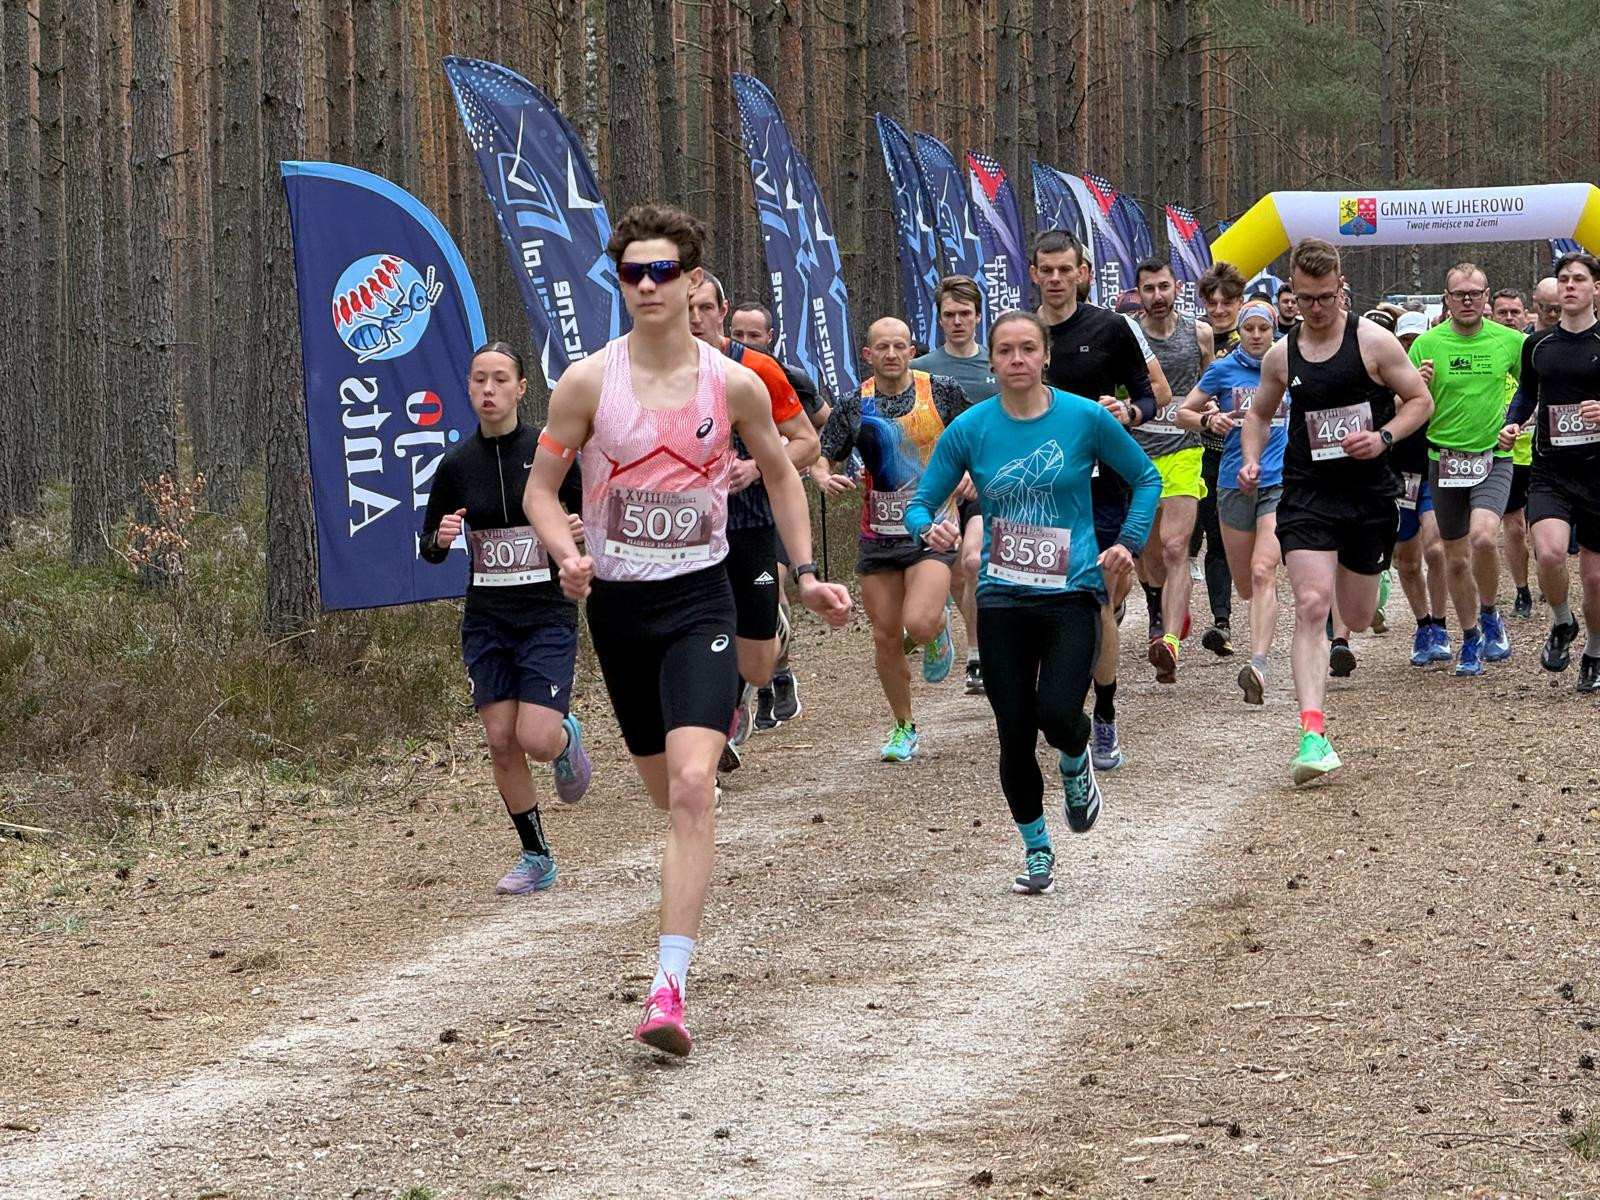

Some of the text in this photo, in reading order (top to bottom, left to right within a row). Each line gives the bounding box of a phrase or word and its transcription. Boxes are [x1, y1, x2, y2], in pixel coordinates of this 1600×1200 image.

[1381, 197, 1524, 217] GMINA WEJHEROWO
[1406, 217, 1498, 231] Twoje miejsce na Ziemi
[1317, 414, 1361, 443] 461
[1447, 458, 1485, 475] 386
[626, 489, 661, 503] XVIII
[877, 500, 912, 522] 35
[622, 503, 698, 541] 509
[1003, 522, 1028, 535] XVIII
[482, 537, 534, 568] 307
[1000, 534, 1056, 568] 358
